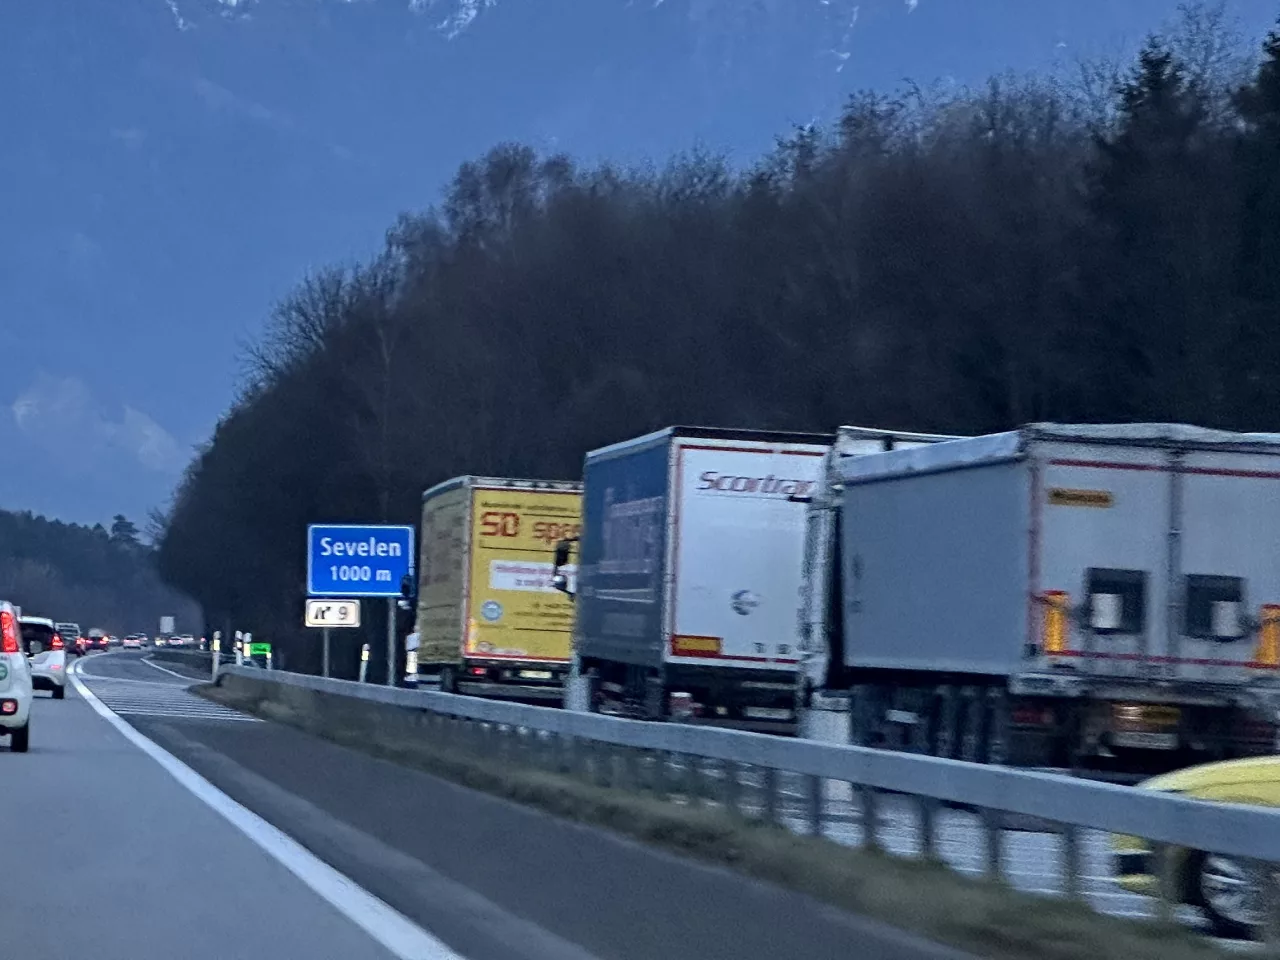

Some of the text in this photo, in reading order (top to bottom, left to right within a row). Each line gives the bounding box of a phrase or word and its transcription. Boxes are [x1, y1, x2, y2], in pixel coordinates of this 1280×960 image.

[320, 536, 402, 557] Sevelen
[329, 565, 392, 582] 1000 m
[338, 605, 348, 621] 9
